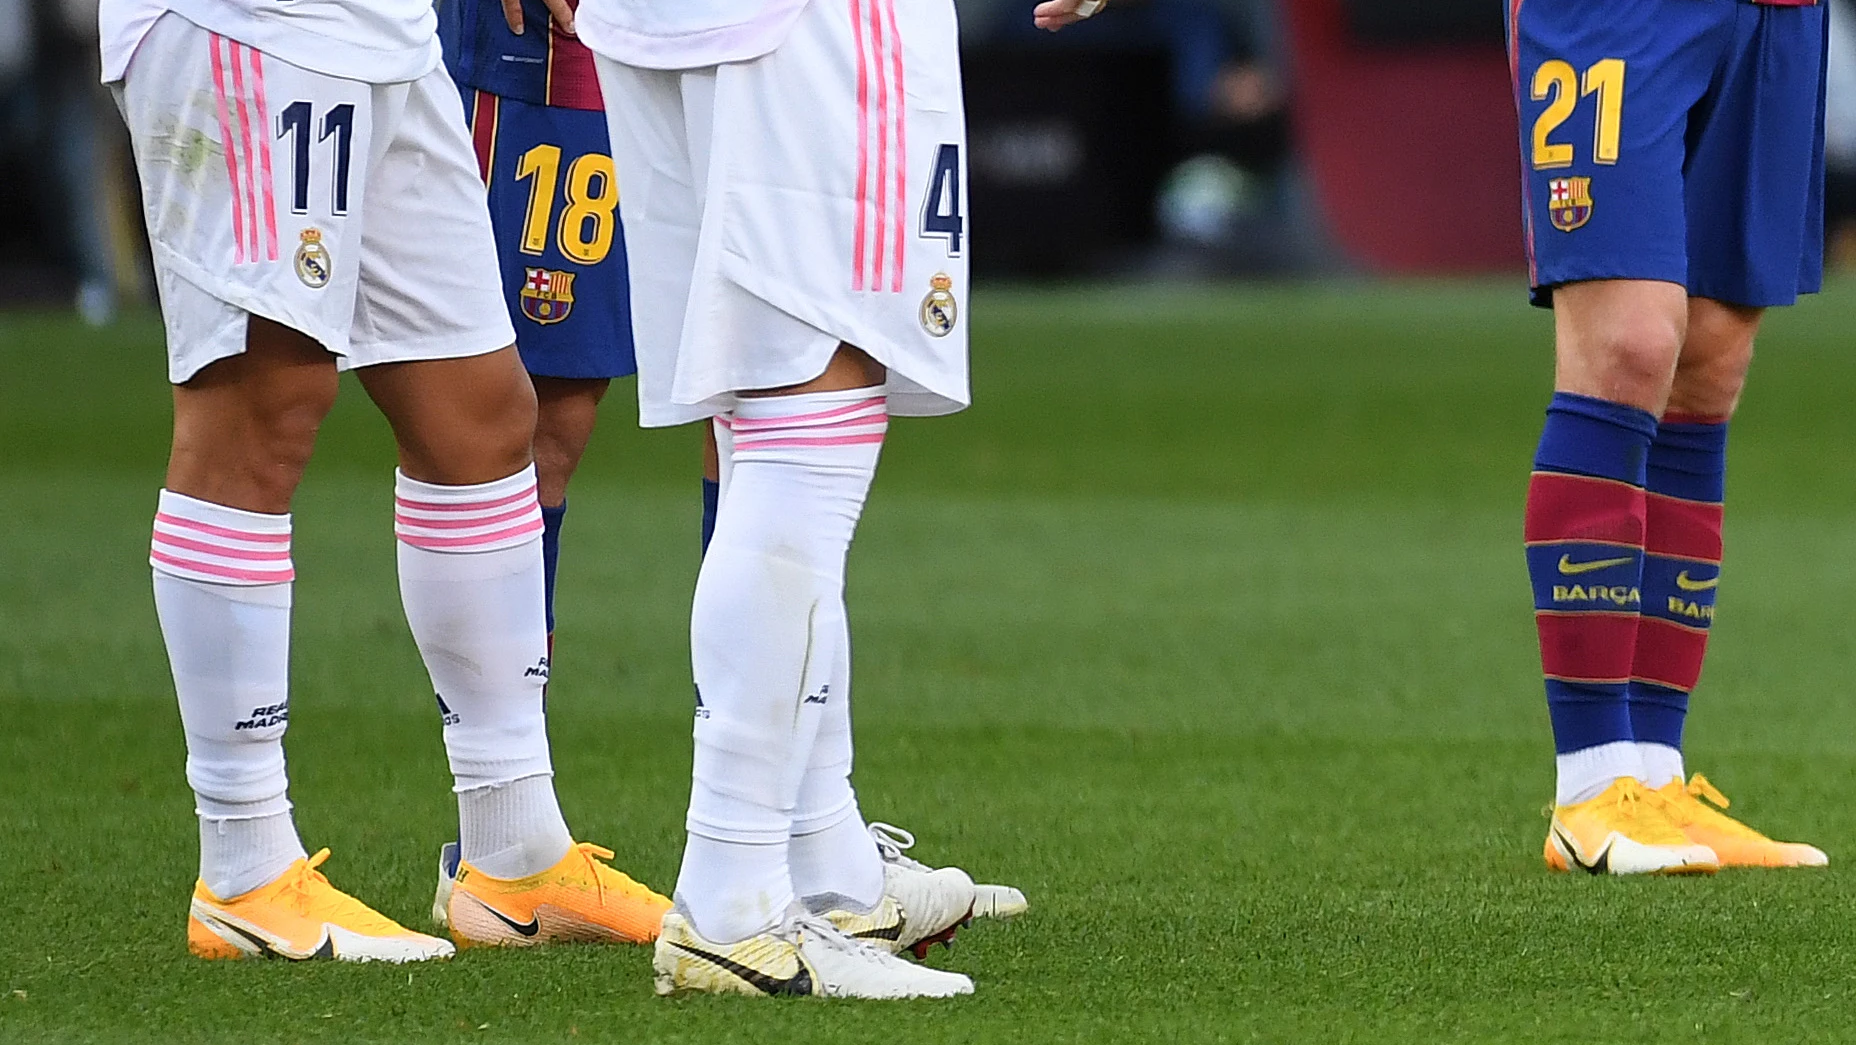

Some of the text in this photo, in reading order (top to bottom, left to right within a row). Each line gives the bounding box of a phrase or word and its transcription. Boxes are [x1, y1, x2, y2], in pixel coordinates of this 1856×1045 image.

[275, 100, 356, 217] 11
[1530, 57, 1626, 171] 21
[515, 143, 620, 265] 18
[918, 142, 964, 259] 4
[251, 702, 288, 718] REA
